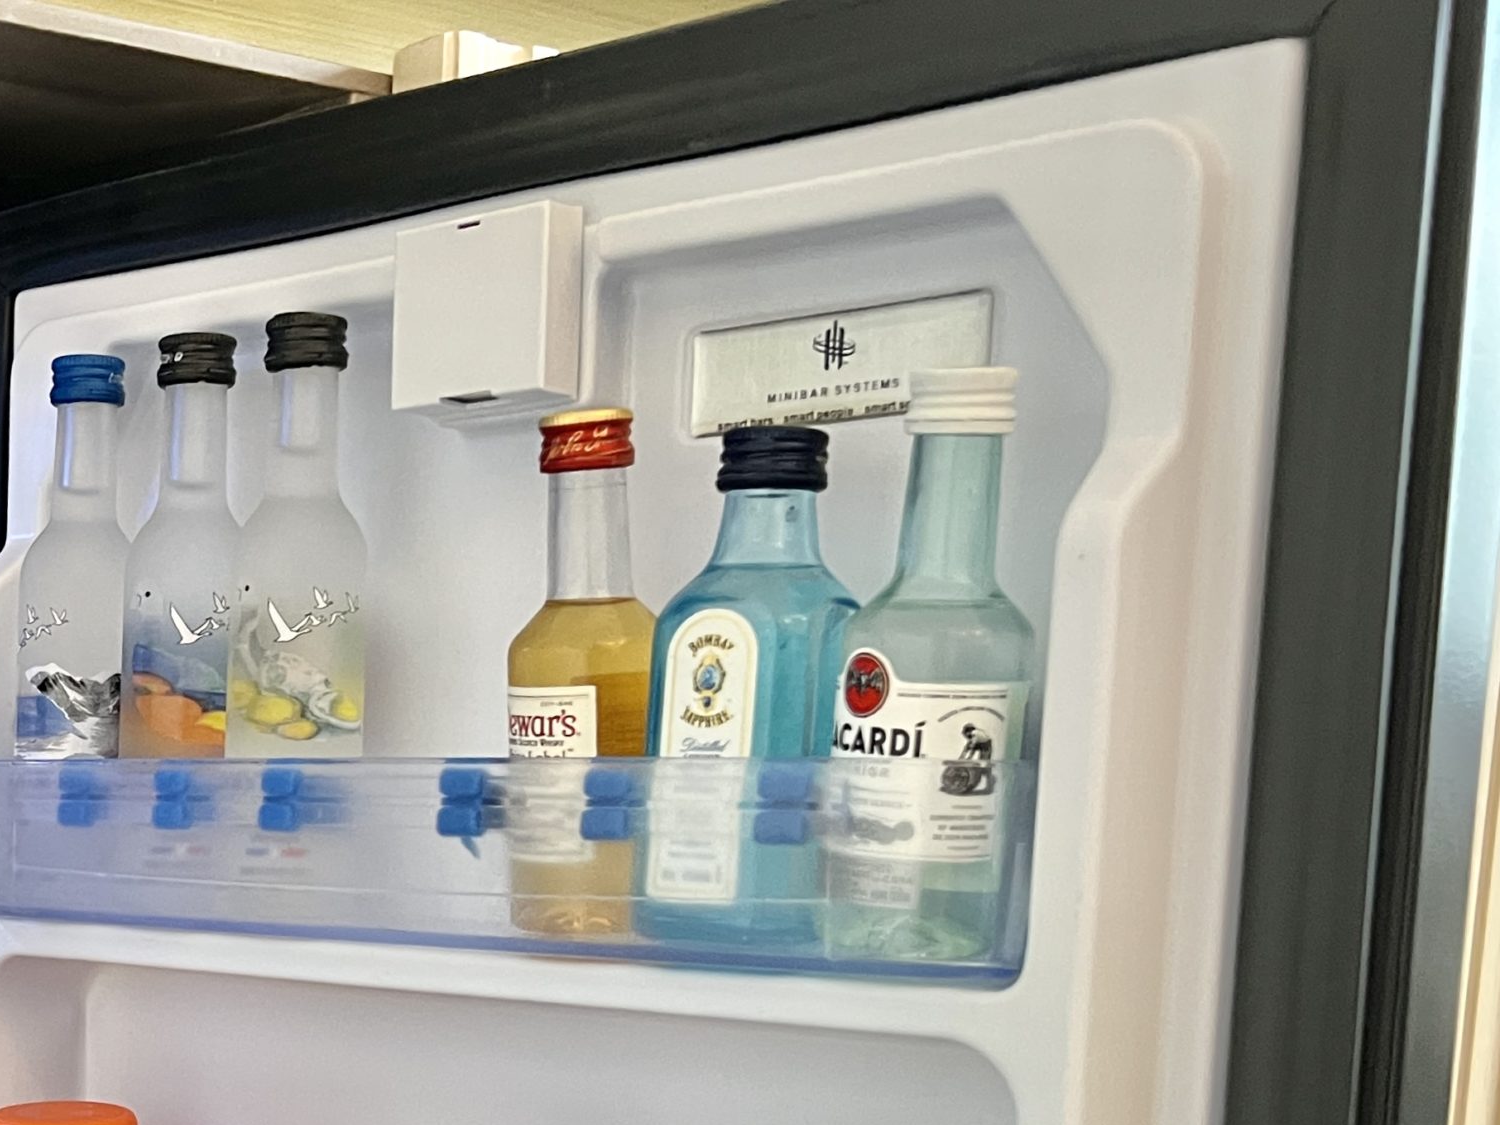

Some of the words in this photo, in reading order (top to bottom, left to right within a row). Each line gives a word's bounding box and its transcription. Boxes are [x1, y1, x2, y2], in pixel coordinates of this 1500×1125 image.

[767, 387, 829, 403] MINIBAR
[835, 378, 900, 396] SYSTEMS
[783, 411, 815, 424] smart
[864, 401, 897, 414] smart
[688, 634, 735, 654] BOMBAY
[509, 708, 577, 738] ewar's
[832, 720, 927, 758] CARDÍ
